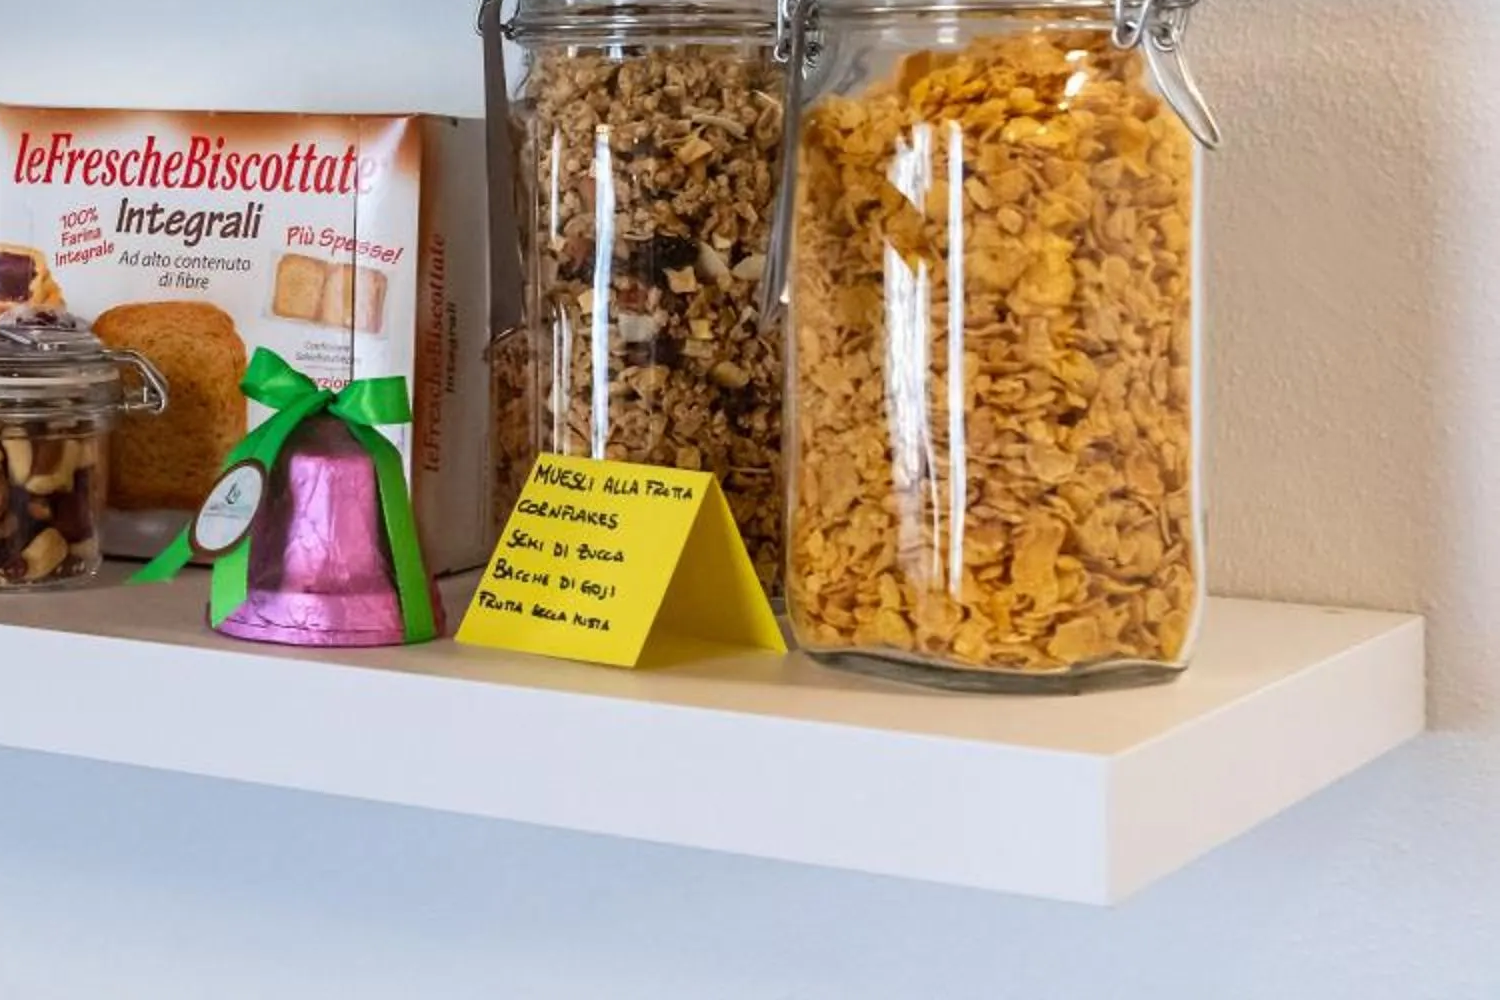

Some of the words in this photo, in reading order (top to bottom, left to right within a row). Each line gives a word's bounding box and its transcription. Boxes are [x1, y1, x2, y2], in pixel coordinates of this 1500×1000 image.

[61, 206, 98, 229] 100%
[116, 197, 264, 247] Integrali
[61, 228, 102, 247] Farina
[287, 226, 315, 247] Più
[319, 227, 405, 264] Spesse!
[55, 240, 114, 267] Integrale
[118, 250, 140, 267] Ad
[141, 251, 171, 268] alto
[174, 254, 251, 271] contenuto
[158, 272, 173, 288] di
[175, 271, 210, 289] fibre
[534, 463, 594, 492] MUESLI
[604, 476, 639, 495] ALLA
[646, 480, 693, 500] FRUTTA
[517, 500, 619, 530] CORNFLAKES
[506, 529, 544, 552] SEMI
[553, 541, 568, 558] DI
[576, 543, 624, 562] ZUCCA
[492, 557, 550, 586] BACCHE
[560, 575, 575, 590] DI
[580, 580, 616, 600] GOJI
[479, 590, 522, 614] FRUTTA
